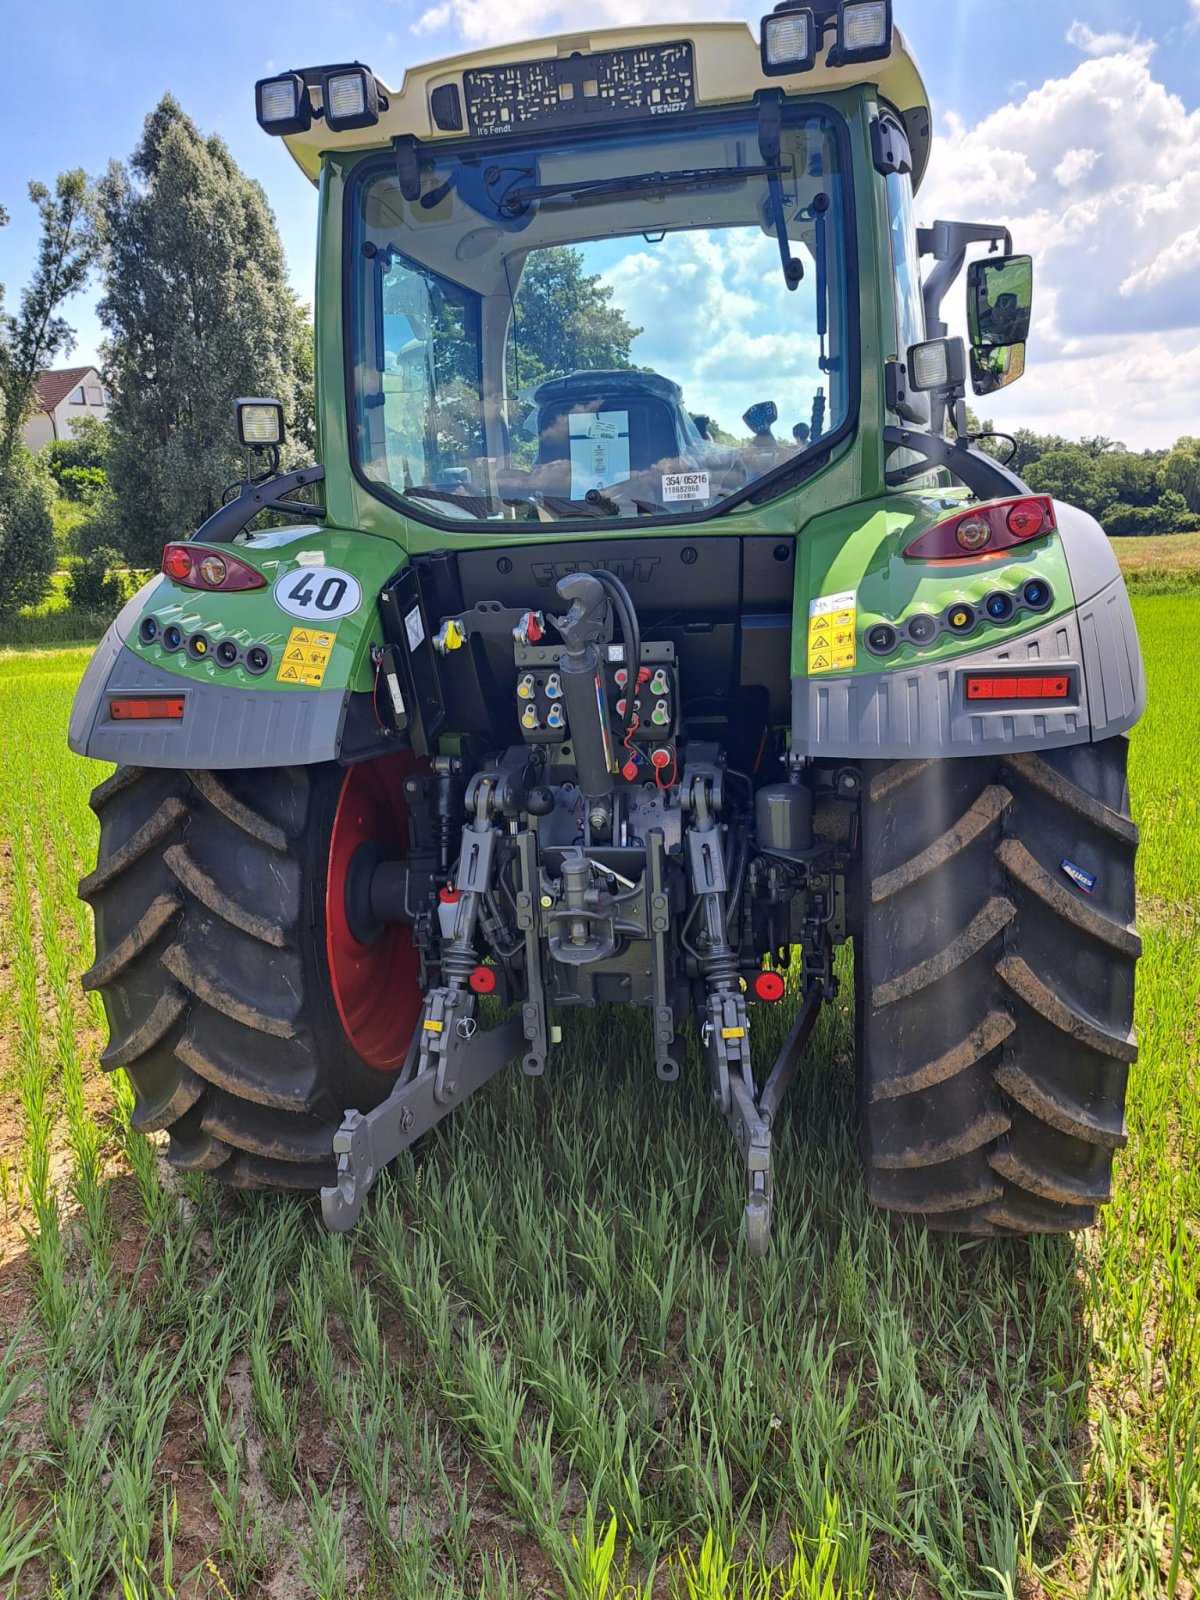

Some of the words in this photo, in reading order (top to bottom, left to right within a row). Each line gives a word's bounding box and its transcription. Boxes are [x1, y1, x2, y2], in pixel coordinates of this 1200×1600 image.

[650, 102, 687, 114] FENDT
[477, 126, 488, 136] It's
[490, 124, 511, 135] Fendt
[288, 572, 348, 611] 40
